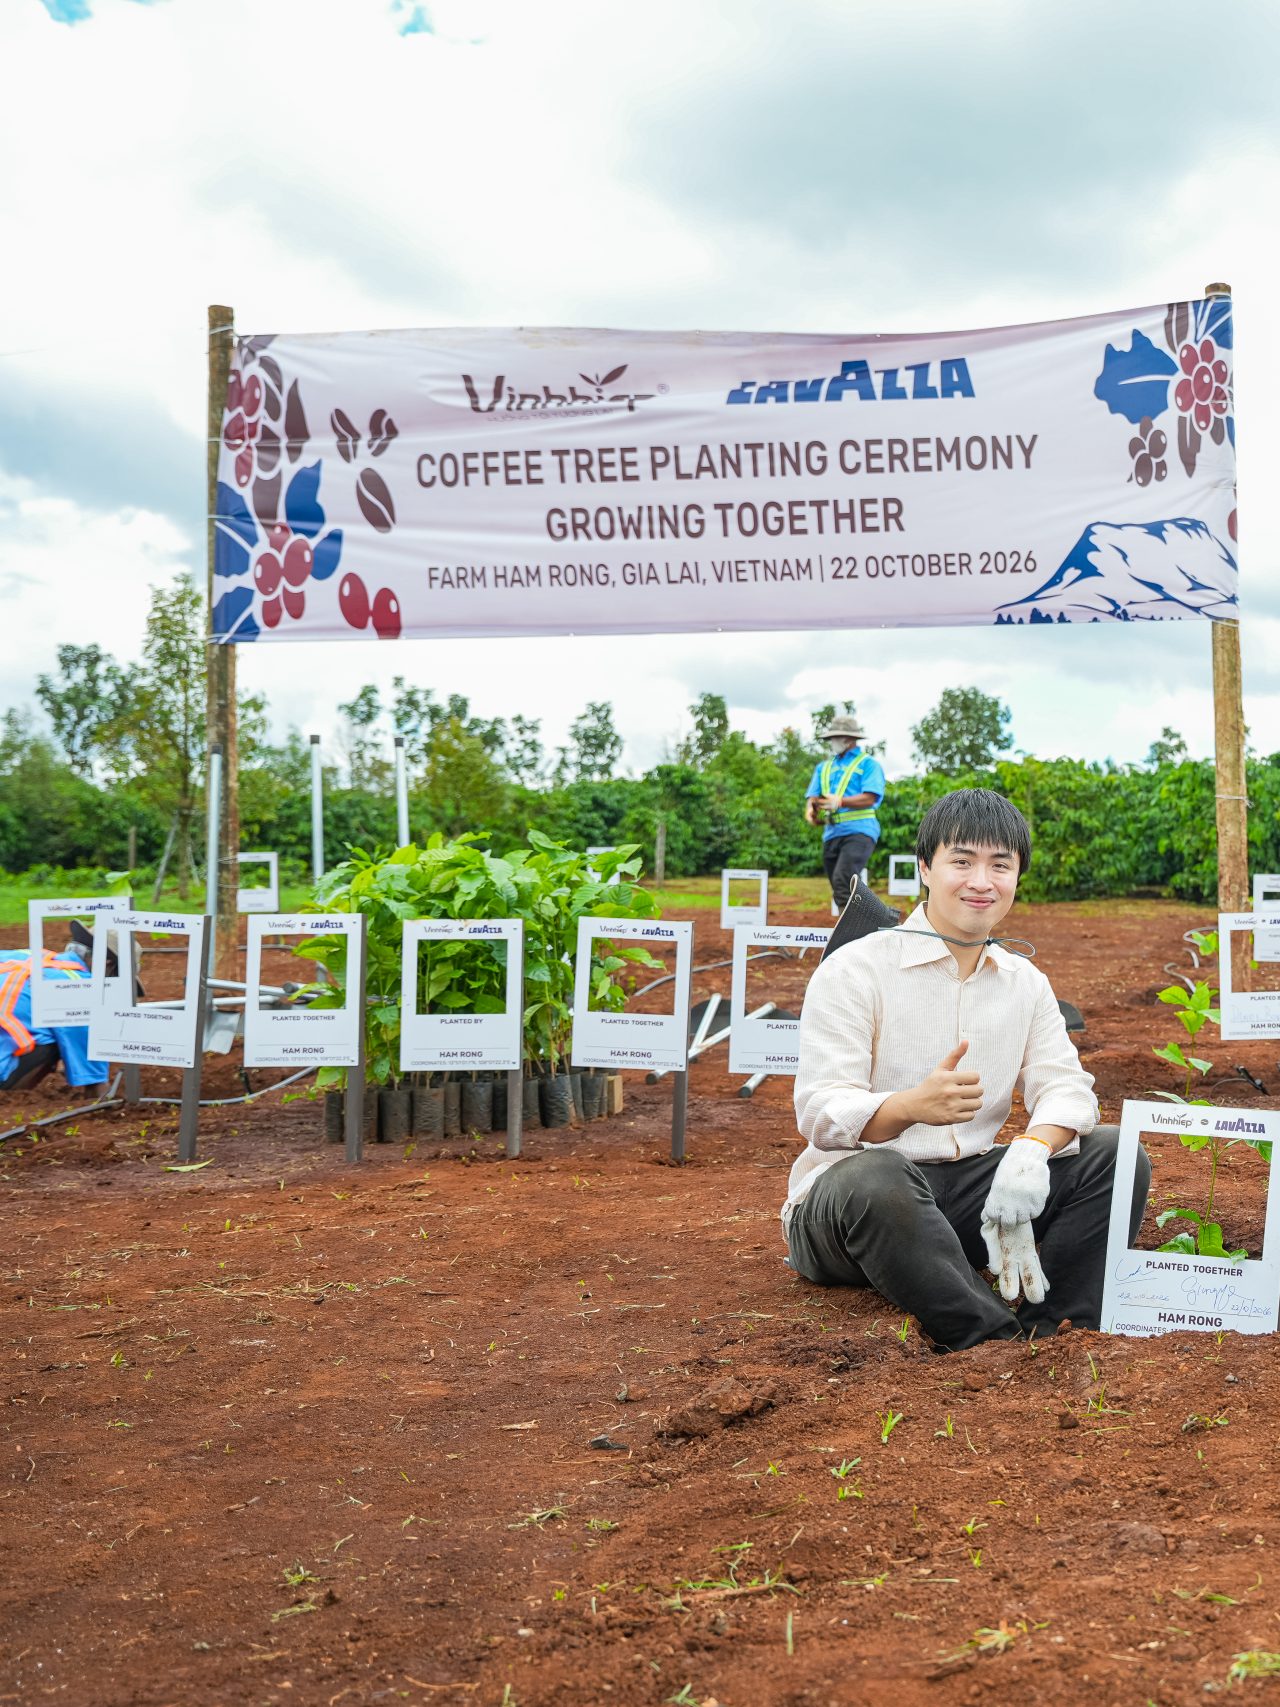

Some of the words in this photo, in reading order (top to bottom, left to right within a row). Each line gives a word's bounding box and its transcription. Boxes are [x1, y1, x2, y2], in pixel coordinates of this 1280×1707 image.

[726, 357, 976, 404] LAVAZZA
[416, 450, 545, 488] COFFEE
[552, 447, 640, 484] TREE
[650, 442, 828, 481] PLANTING
[838, 434, 1038, 474] CEREMONY
[546, 504, 706, 542] GROWING
[715, 498, 905, 538] TOGETHER
[428, 564, 488, 589] FARM
[494, 564, 545, 588] HAM
[549, 562, 616, 590] RONG,
[622, 562, 660, 586] GIA
[666, 560, 708, 587] LAI,
[712, 557, 812, 584] VIETNAM
[831, 556, 857, 580] 22
[866, 553, 972, 579] OCTOBER
[980, 550, 1038, 575] 2026
[154, 919, 185, 929] LAVAZZA
[311, 920, 344, 929] LAVAZZA
[468, 925, 503, 934] LAVAZZA
[642, 927, 674, 937] LAVAZZA
[795, 933, 828, 942] LAVAZZA
[114, 1012, 141, 1020] PLANTED
[144, 1013, 173, 1021] TOGETHER
[632, 1019, 664, 1027] TOGETHER
[141, 1045, 161, 1053] RONG
[1214, 1118, 1266, 1134] LAVAZZA
[1146, 1260, 1190, 1272] PLANTED
[1193, 1264, 1243, 1277] TOGETHER
[1158, 1312, 1187, 1324] HAM
[1188, 1315, 1223, 1327] RONG
